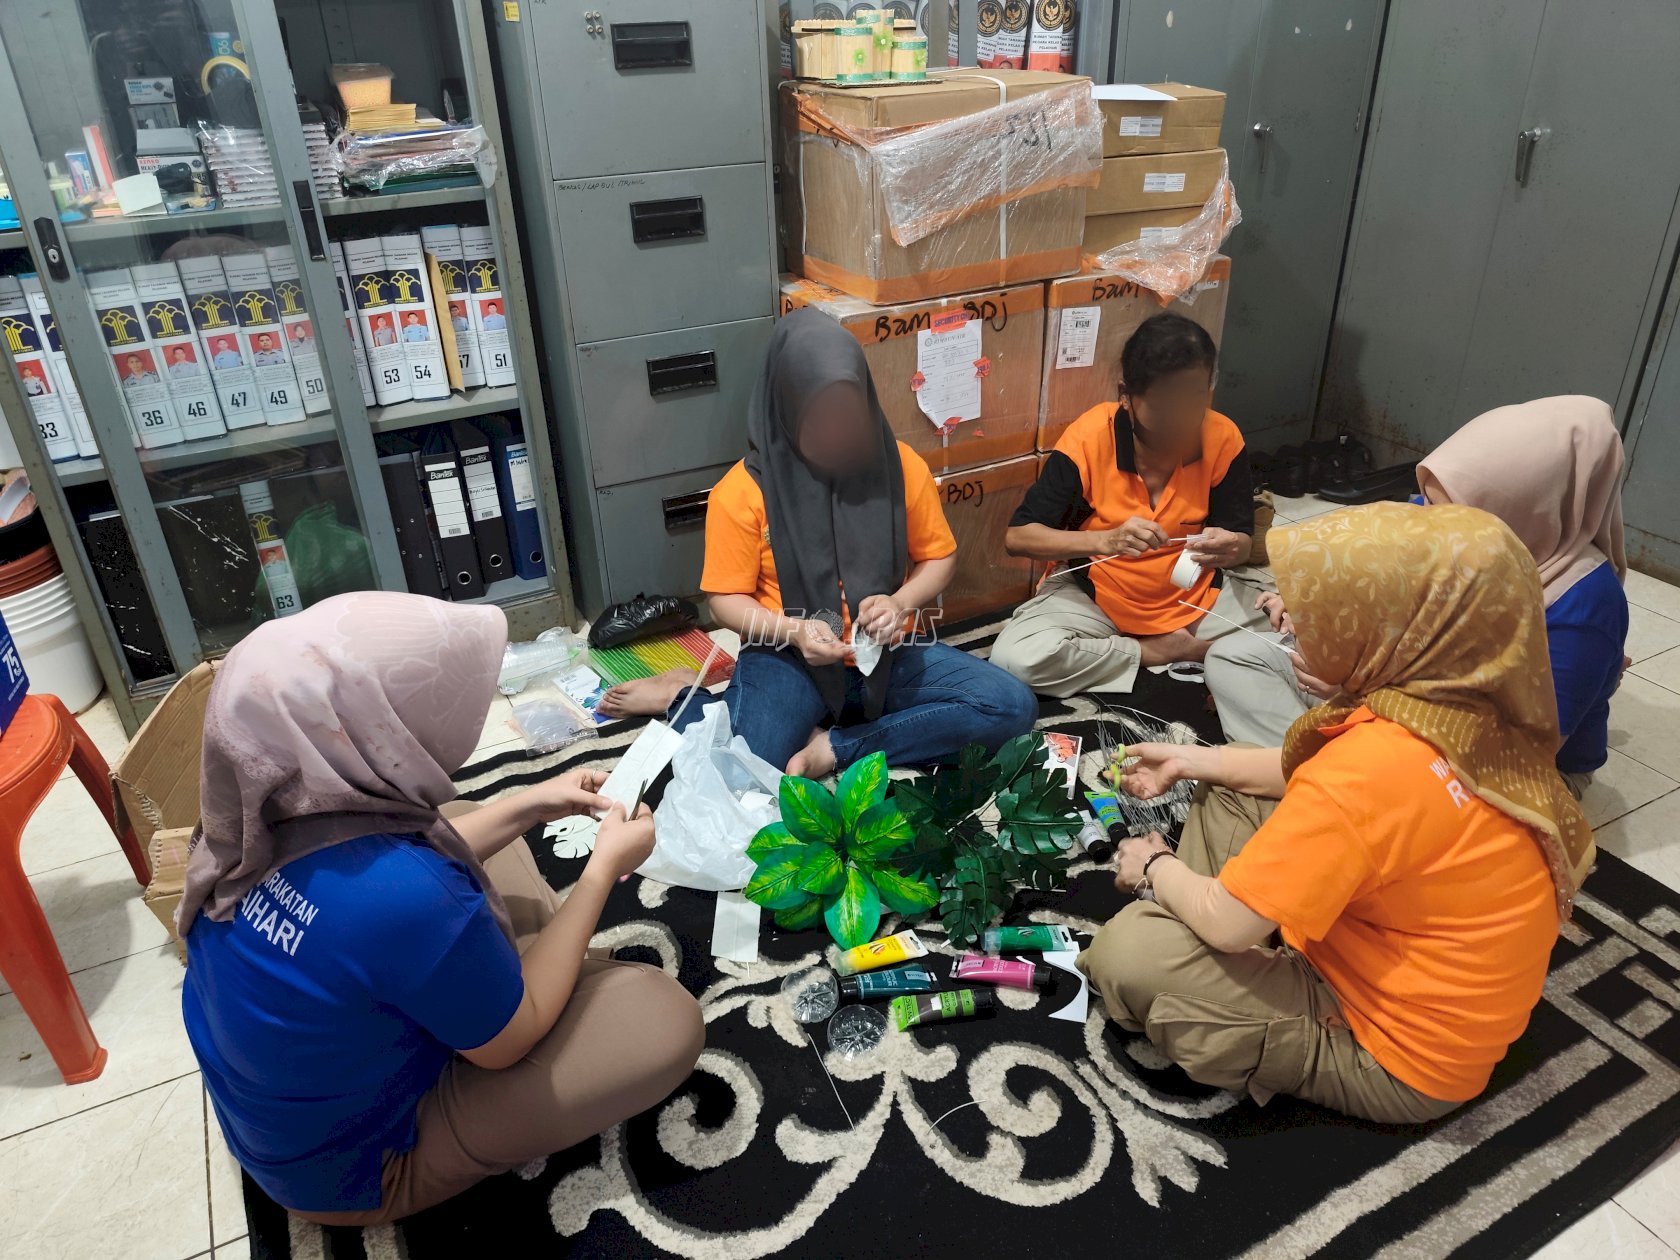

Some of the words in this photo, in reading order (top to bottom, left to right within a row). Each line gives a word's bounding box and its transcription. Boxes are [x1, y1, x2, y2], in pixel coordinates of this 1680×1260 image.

[495, 354, 508, 368] 51
[383, 368, 401, 385] 53
[414, 365, 431, 380] 54
[306, 378, 324, 395] 50
[230, 391, 247, 408] 47
[270, 389, 288, 406] 49
[187, 401, 207, 418] 46
[142, 409, 164, 428] 36
[465, 454, 487, 465] Bantex
[430, 469, 454, 480] Bantex
[275, 594, 295, 610] 63
[264, 871, 320, 927] RAKATAN
